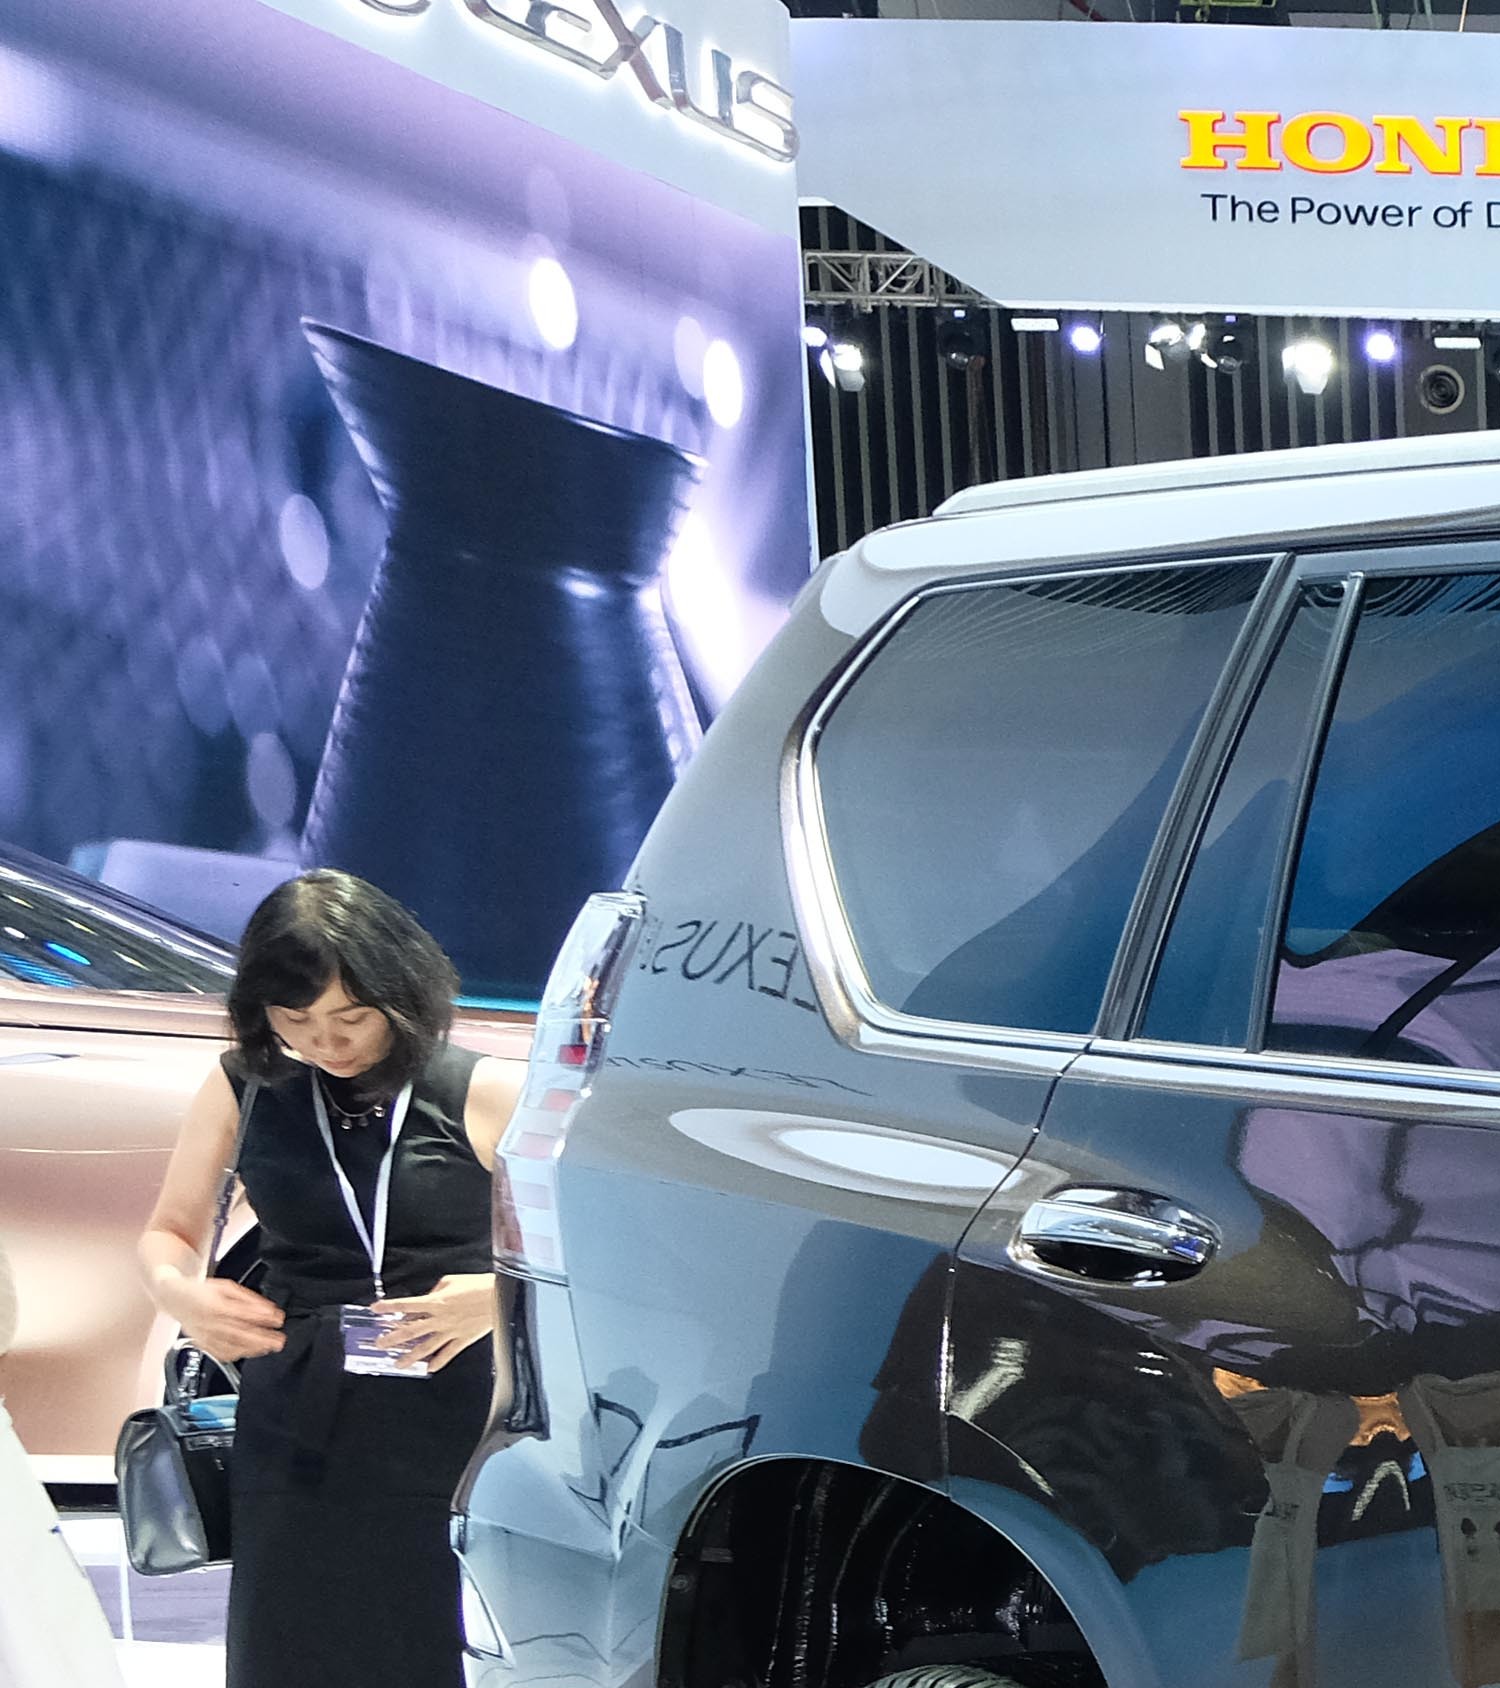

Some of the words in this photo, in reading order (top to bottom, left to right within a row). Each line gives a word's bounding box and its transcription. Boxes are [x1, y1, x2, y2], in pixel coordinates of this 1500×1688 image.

[1201, 193, 1280, 224] The
[1290, 196, 1424, 229] Power
[1432, 199, 1473, 229] of
